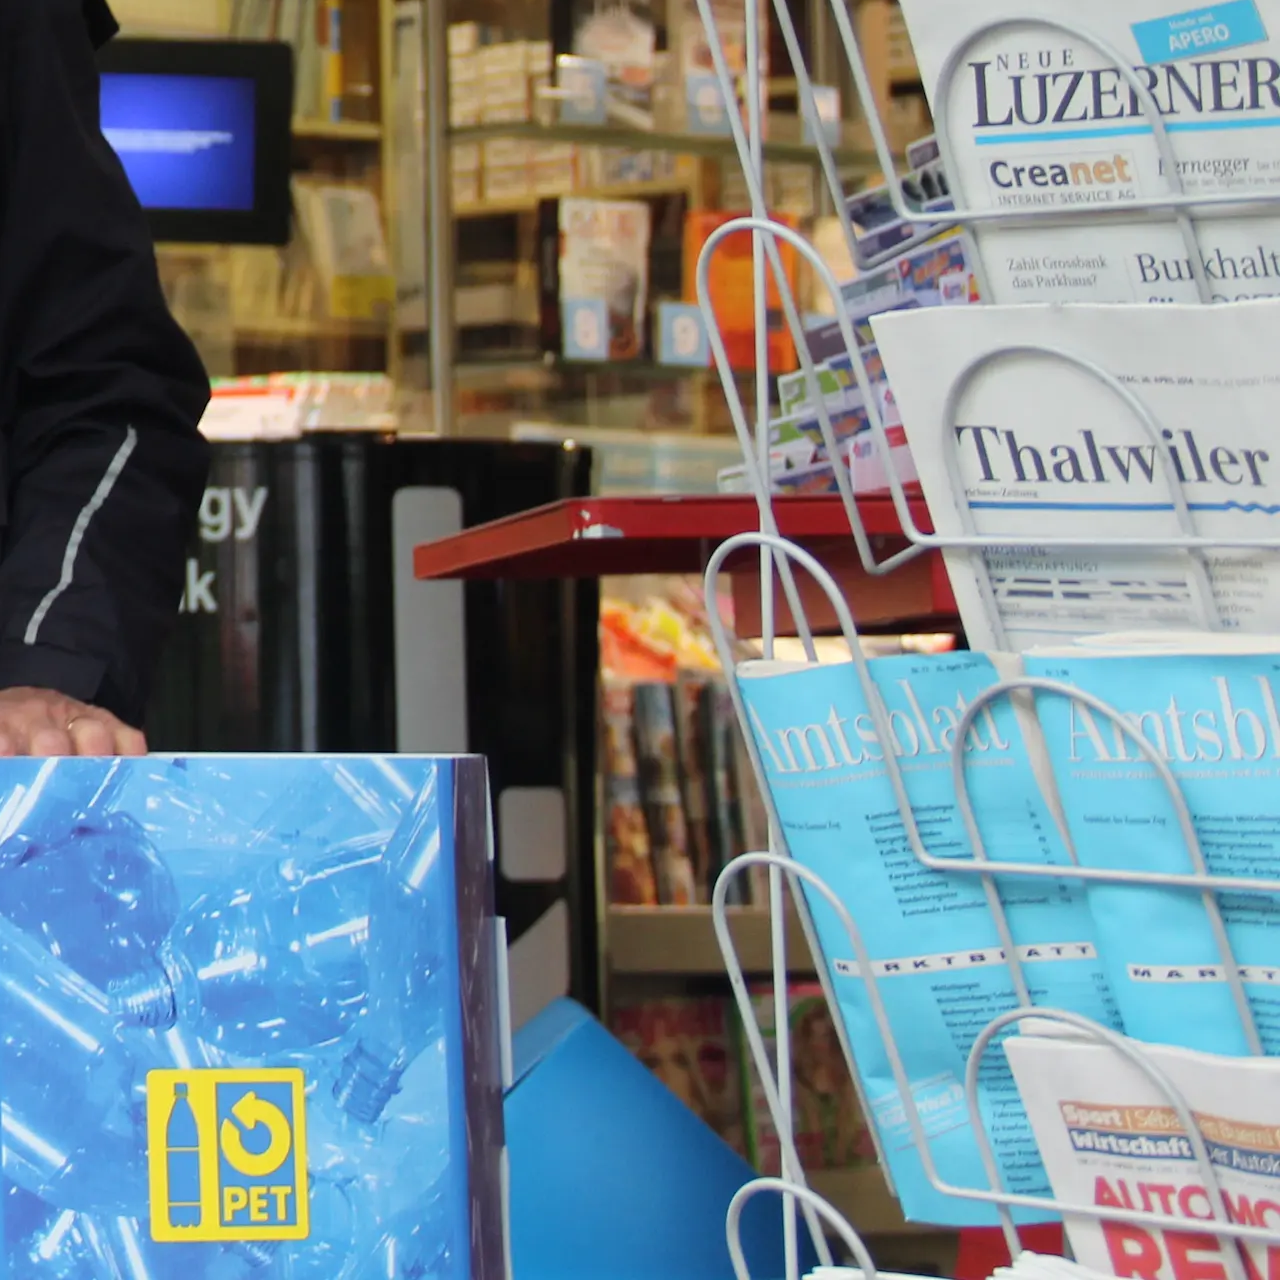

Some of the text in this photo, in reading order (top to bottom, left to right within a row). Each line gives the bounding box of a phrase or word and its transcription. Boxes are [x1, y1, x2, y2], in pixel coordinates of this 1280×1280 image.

[1167, 24, 1230, 52] APERO
[995, 47, 1075, 72] NEUE
[967, 56, 1280, 129] LUZERNER
[988, 153, 1133, 189] Creanet
[997, 187, 1137, 206] INTERNET SERVICE AG
[1041, 253, 1109, 272] Grossbank
[1011, 271, 1099, 290] das Parkhaus?
[954, 425, 1270, 487] Thalwiler
[178, 558, 218, 614] k
[1061, 1103, 1124, 1128] Sport
[1069, 1129, 1193, 1157] Wirtschaft
[223, 1185, 293, 1224] PET
